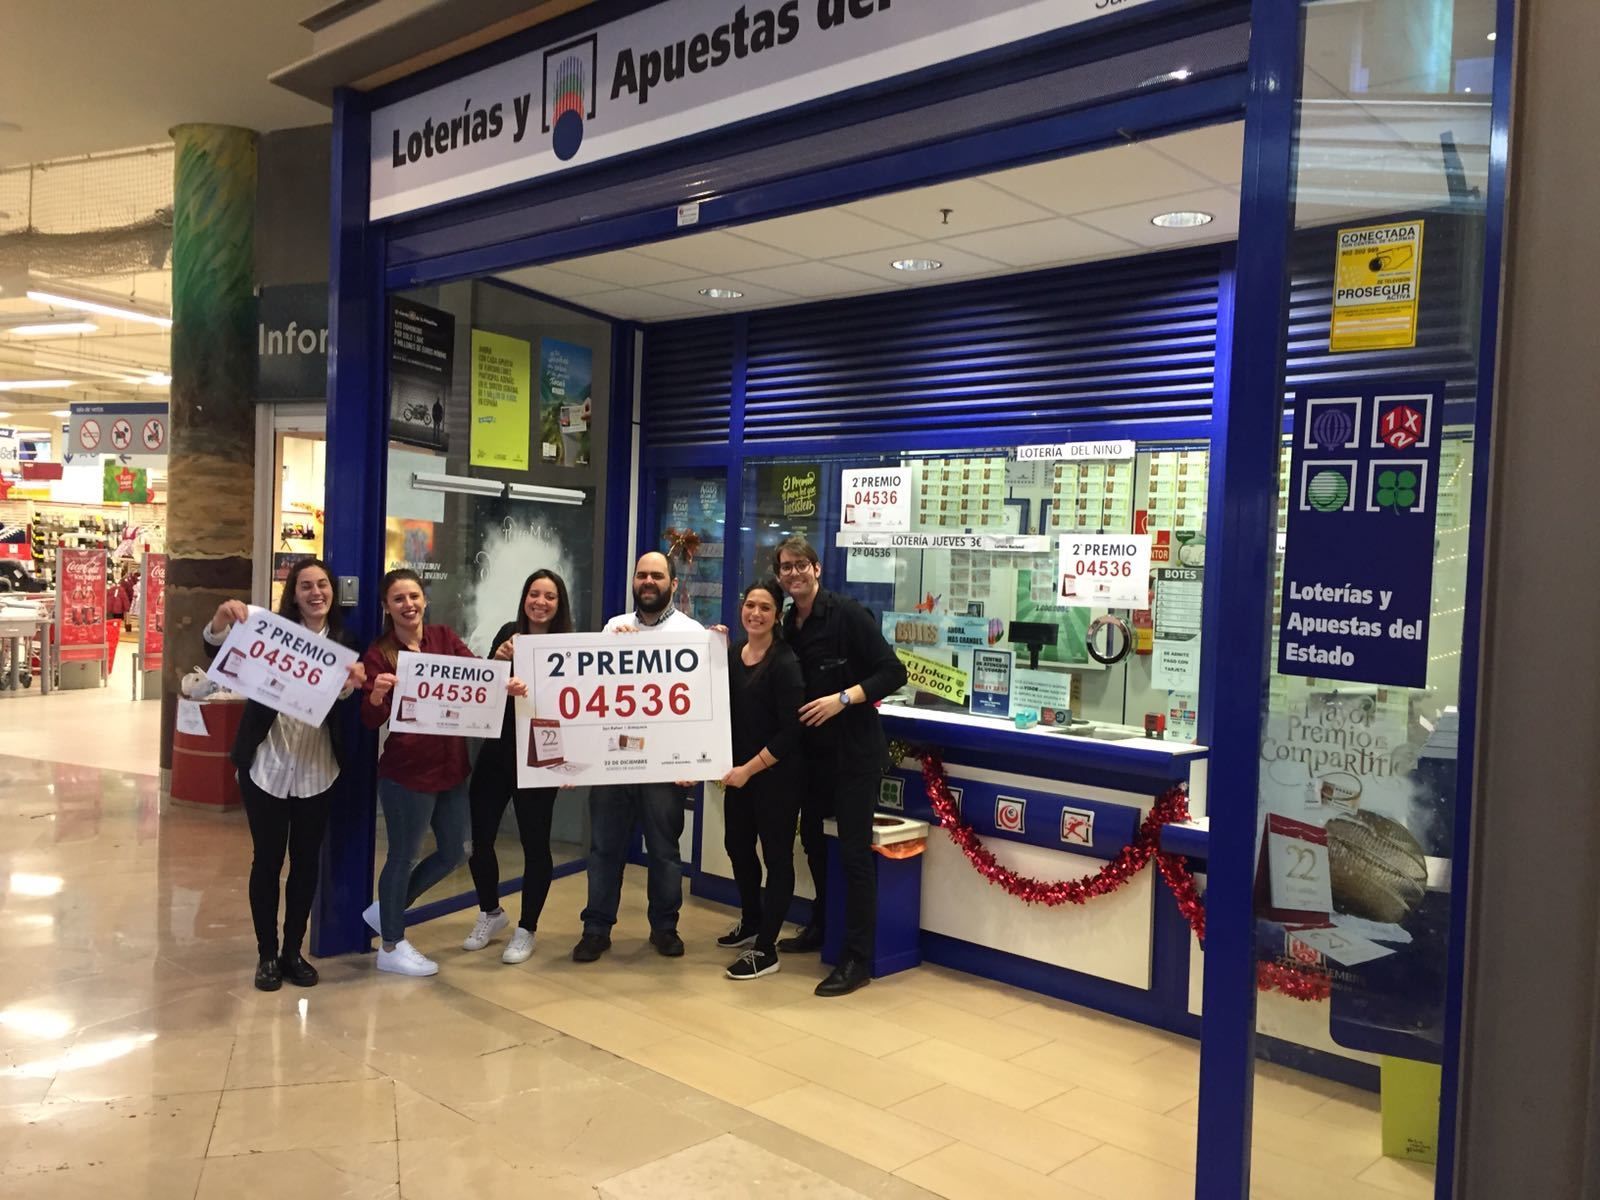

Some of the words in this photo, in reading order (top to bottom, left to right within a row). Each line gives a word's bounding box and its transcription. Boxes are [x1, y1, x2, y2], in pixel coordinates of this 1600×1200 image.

[392, 99, 503, 168] Loterías
[513, 93, 531, 142] y
[610, 0, 799, 104] Apuestas
[1341, 227, 1415, 244] CONECTADA
[1355, 239, 1377, 247] CENTRAL
[1337, 283, 1411, 300] PROSEGUR
[258, 321, 328, 355] Infor
[1385, 412, 1396, 432] 1
[1404, 410, 1417, 431] X
[1071, 445, 1089, 455] DEL
[862, 476, 902, 487] PREMIO
[855, 491, 897, 505] 04536
[892, 535, 928, 547] LOTERÍA
[932, 537, 966, 547] JUEVES
[971, 538, 982, 547] 3€
[1085, 544, 1137, 556] PREMIO
[864, 548, 890, 557] 04536
[1076, 560, 1131, 577] 04536
[1165, 570, 1197, 579] BOTES
[1290, 581, 1373, 605] Loterías
[1379, 589, 1393, 611] y
[1287, 612, 1382, 637] Apuestas
[1389, 618, 1423, 641] del
[270, 626, 337, 666] PREMIO
[1285, 643, 1355, 667] Estado
[250, 640, 323, 686] 04536
[578, 648, 699, 676] PREMIO
[430, 664, 495, 682] PREMIO
[921, 665, 953, 682] Joker
[417, 682, 488, 704] 04536
[559, 682, 691, 720] 04536
[541, 730, 559, 746] 22
[1287, 715, 1372, 751] Premio
[1286, 844, 1320, 882] 22
